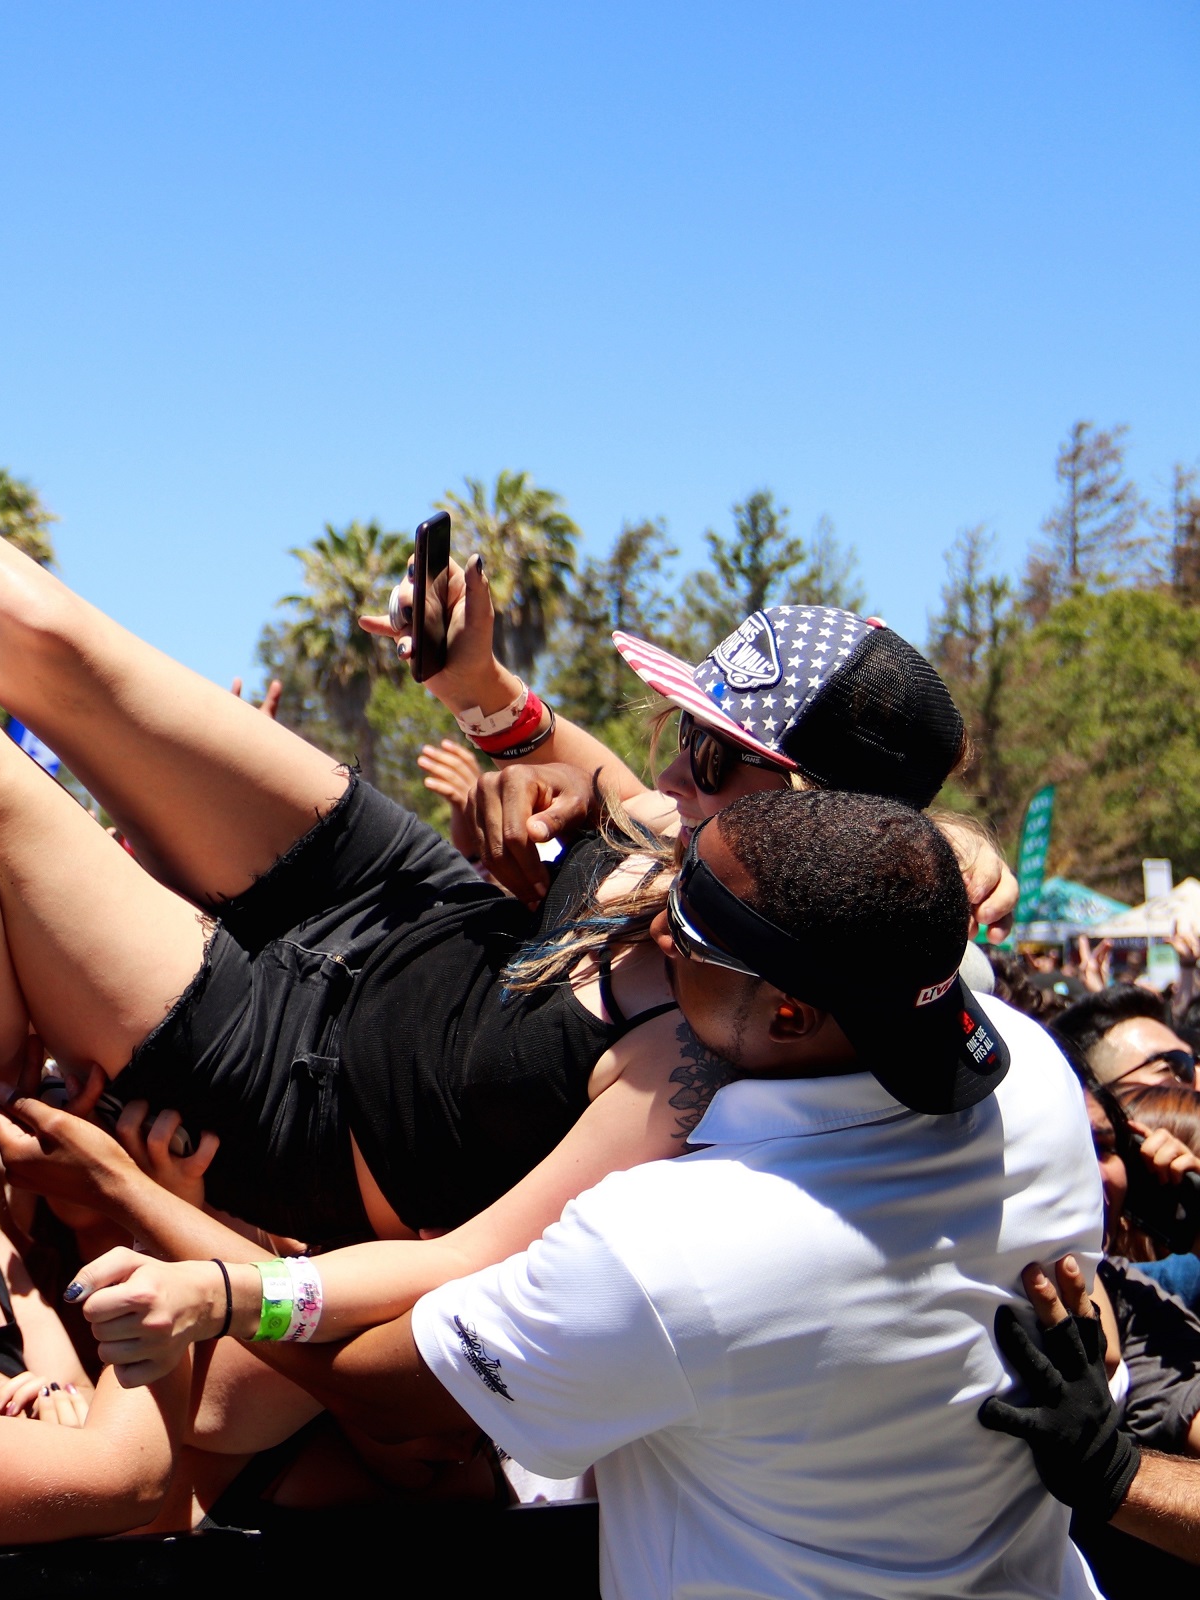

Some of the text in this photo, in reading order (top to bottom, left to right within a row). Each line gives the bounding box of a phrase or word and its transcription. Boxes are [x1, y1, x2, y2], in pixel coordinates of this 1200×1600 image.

[737, 617, 762, 643] ANS
[520, 744, 535, 753] HOPE
[966, 1036, 980, 1053] ONE
[975, 1025, 987, 1042] SIZE
[972, 1044, 988, 1064] FITS
[983, 1036, 994, 1052] ALL
[461, 1340, 483, 1376] MOUNTAIN
[482, 1375, 498, 1393] VIEW
